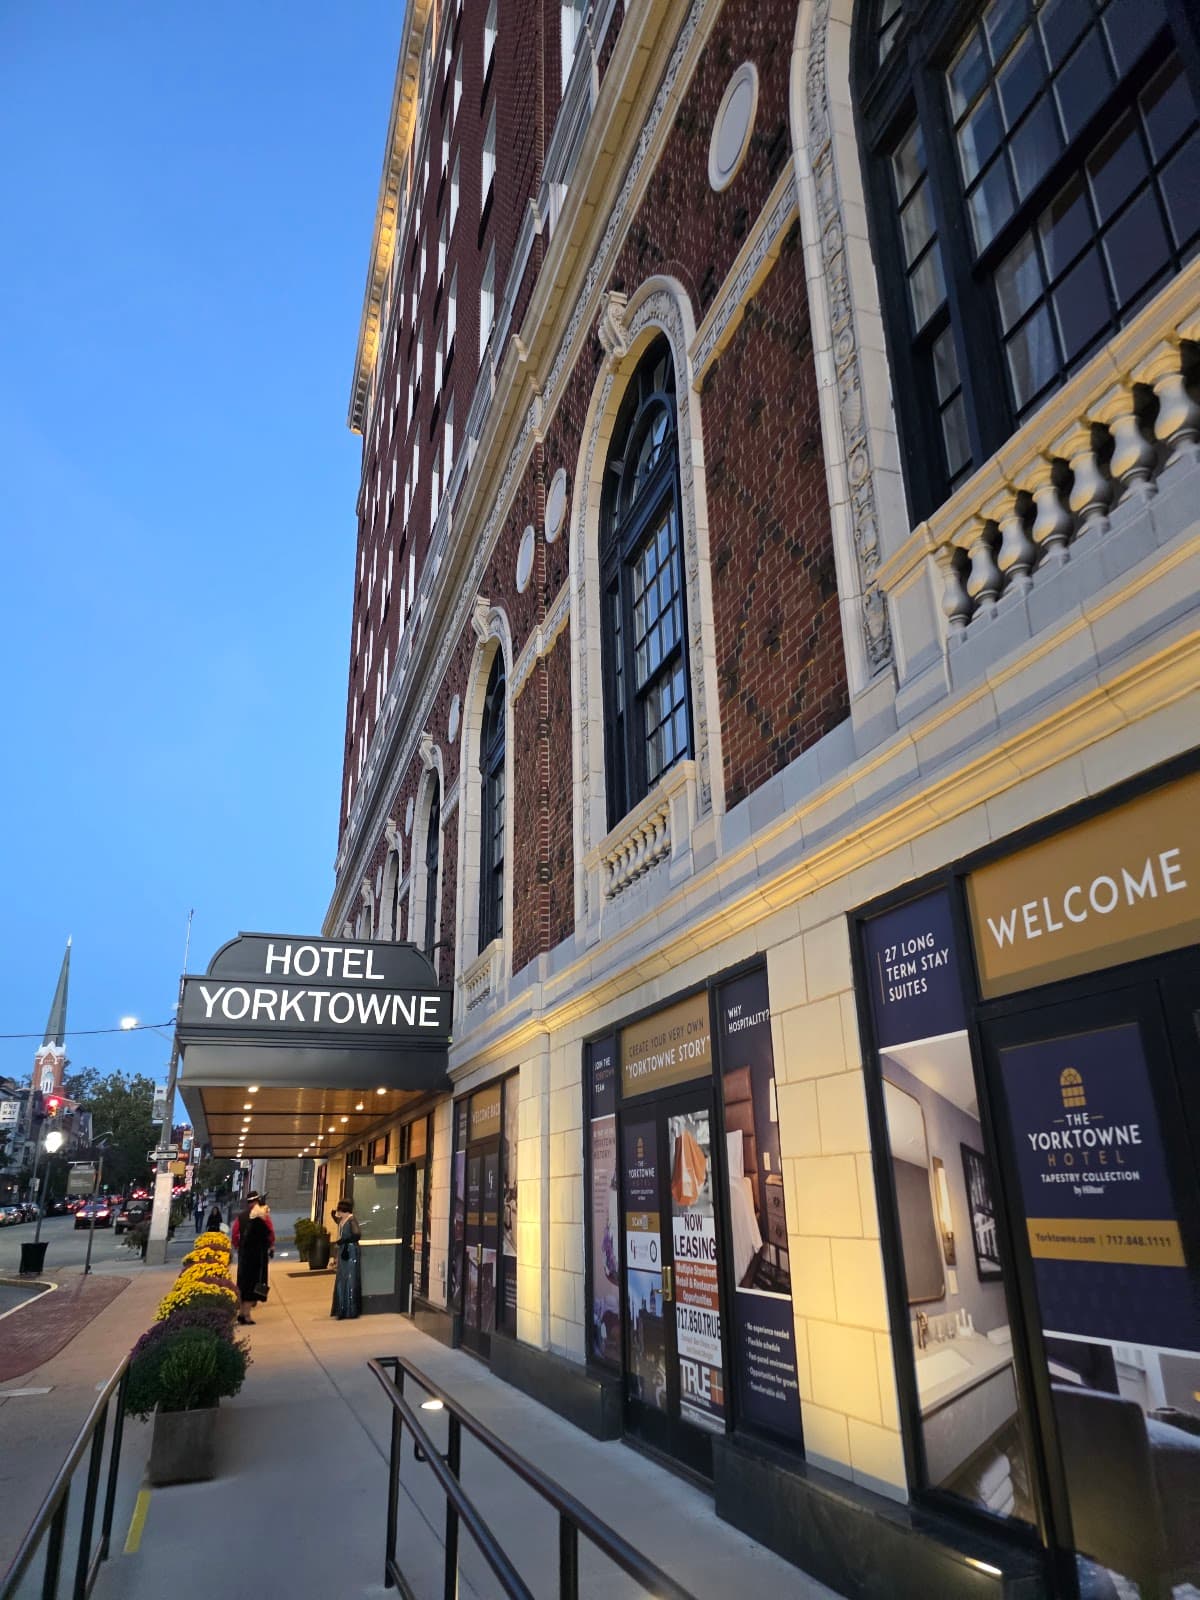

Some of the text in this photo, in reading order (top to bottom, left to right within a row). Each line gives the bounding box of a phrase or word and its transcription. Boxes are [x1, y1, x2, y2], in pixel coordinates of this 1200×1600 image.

[987, 848, 1188, 948] WELCOME
[885, 932, 935, 963] 27 LONG
[265, 943, 385, 980] HOTEL
[886, 948, 950, 983] TERM STAY
[889, 977, 928, 1002] SUITES
[199, 986, 441, 1027] YORKTOWNE
[728, 1004, 742, 1019] WHY
[728, 1008, 770, 1034] HOSPITALITY?
[629, 1016, 704, 1058] CREATE YOUR VERY OWN
[603, 1056, 611, 1067] THE
[1065, 1112, 1091, 1126] THE
[1027, 1124, 1143, 1151] YORKTOWNE
[1047, 1150, 1125, 1167] HOTEL
[628, 1167, 655, 1178] YORKTOWNE
[1040, 1171, 1140, 1183] TAPESTRY COLLECTION
[1073, 1185, 1082, 1196] by
[684, 1213, 703, 1232] NOW
[674, 1235, 717, 1260] LEASING
[677, 1307, 721, 1340] 717.850.TRUE
[680, 1358, 712, 1401] TRUE
